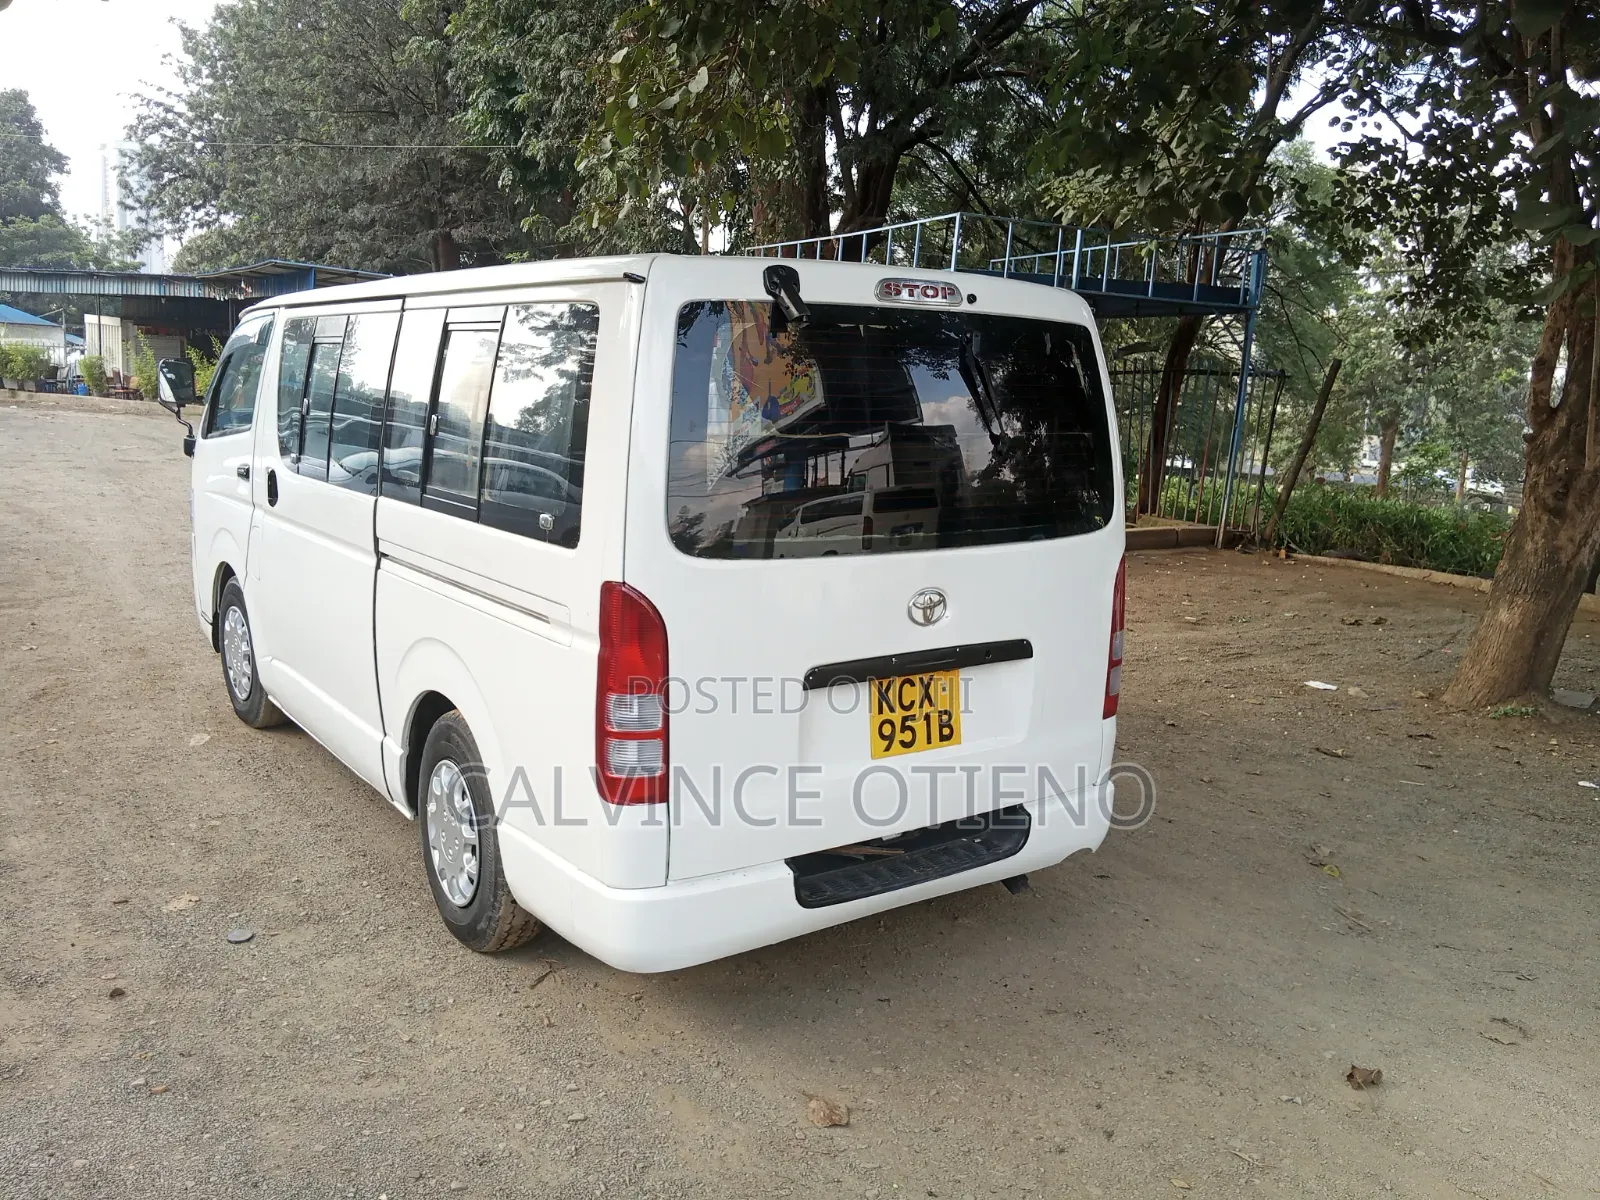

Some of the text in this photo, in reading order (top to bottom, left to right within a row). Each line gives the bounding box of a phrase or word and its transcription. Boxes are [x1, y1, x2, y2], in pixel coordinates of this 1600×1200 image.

[884, 282, 956, 299] STOP
[877, 675, 936, 715] KCX
[877, 709, 955, 752] 951B
